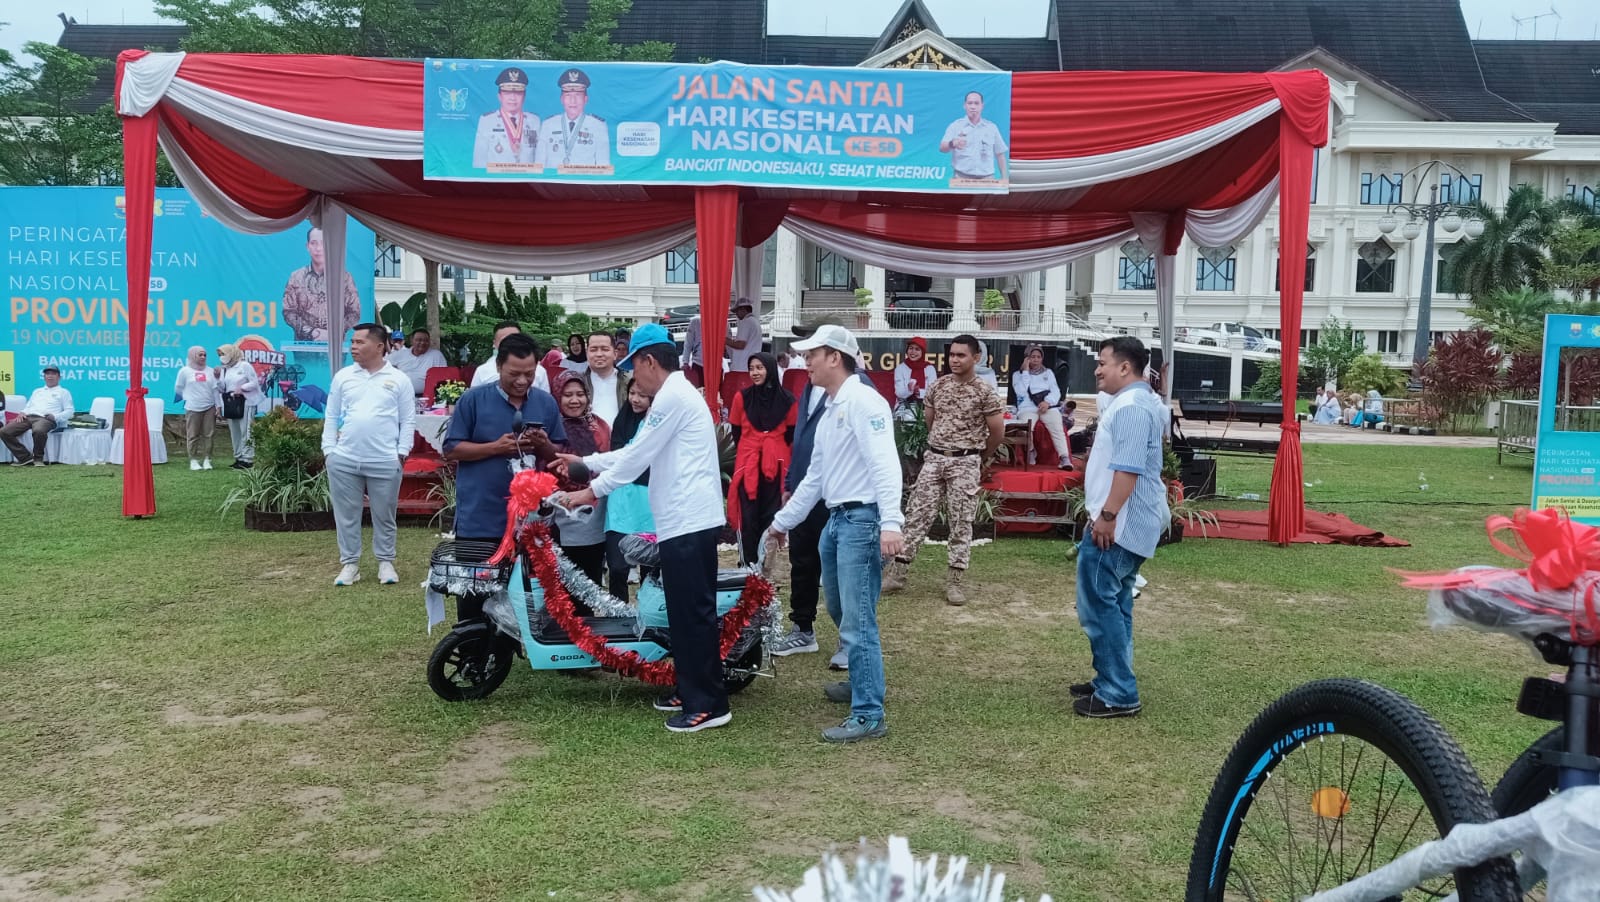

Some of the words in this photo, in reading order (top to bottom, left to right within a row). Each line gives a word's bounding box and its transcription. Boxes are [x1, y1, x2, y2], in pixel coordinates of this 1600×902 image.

[672, 74, 775, 101] JALAN
[786, 79, 904, 107] SANTAI
[667, 105, 737, 127] HARI
[742, 107, 914, 134] KESEHATAN
[691, 129, 841, 155] NASIONAL
[664, 157, 725, 172] BANGKIT
[727, 159, 825, 177] INDONESIAKU,
[829, 163, 874, 177] SEHAT
[876, 165, 946, 180] NEGERIKU
[9, 226, 128, 242] PERINGATA
[8, 249, 60, 265] HARI
[69, 250, 197, 267] KESETAN
[9, 275, 121, 291] NASIONAL
[175, 298, 277, 328] JAMBI
[12, 329, 31, 345] 19
[39, 355, 101, 367] BANGKIT
[105, 356, 188, 369] INDNESIA
[242, 349, 284, 366] RPRIZE
[39, 369, 84, 381] SHAT
[88, 370, 160, 382] NEGEKU
[1541, 449, 1591, 457] PERINGATAN
